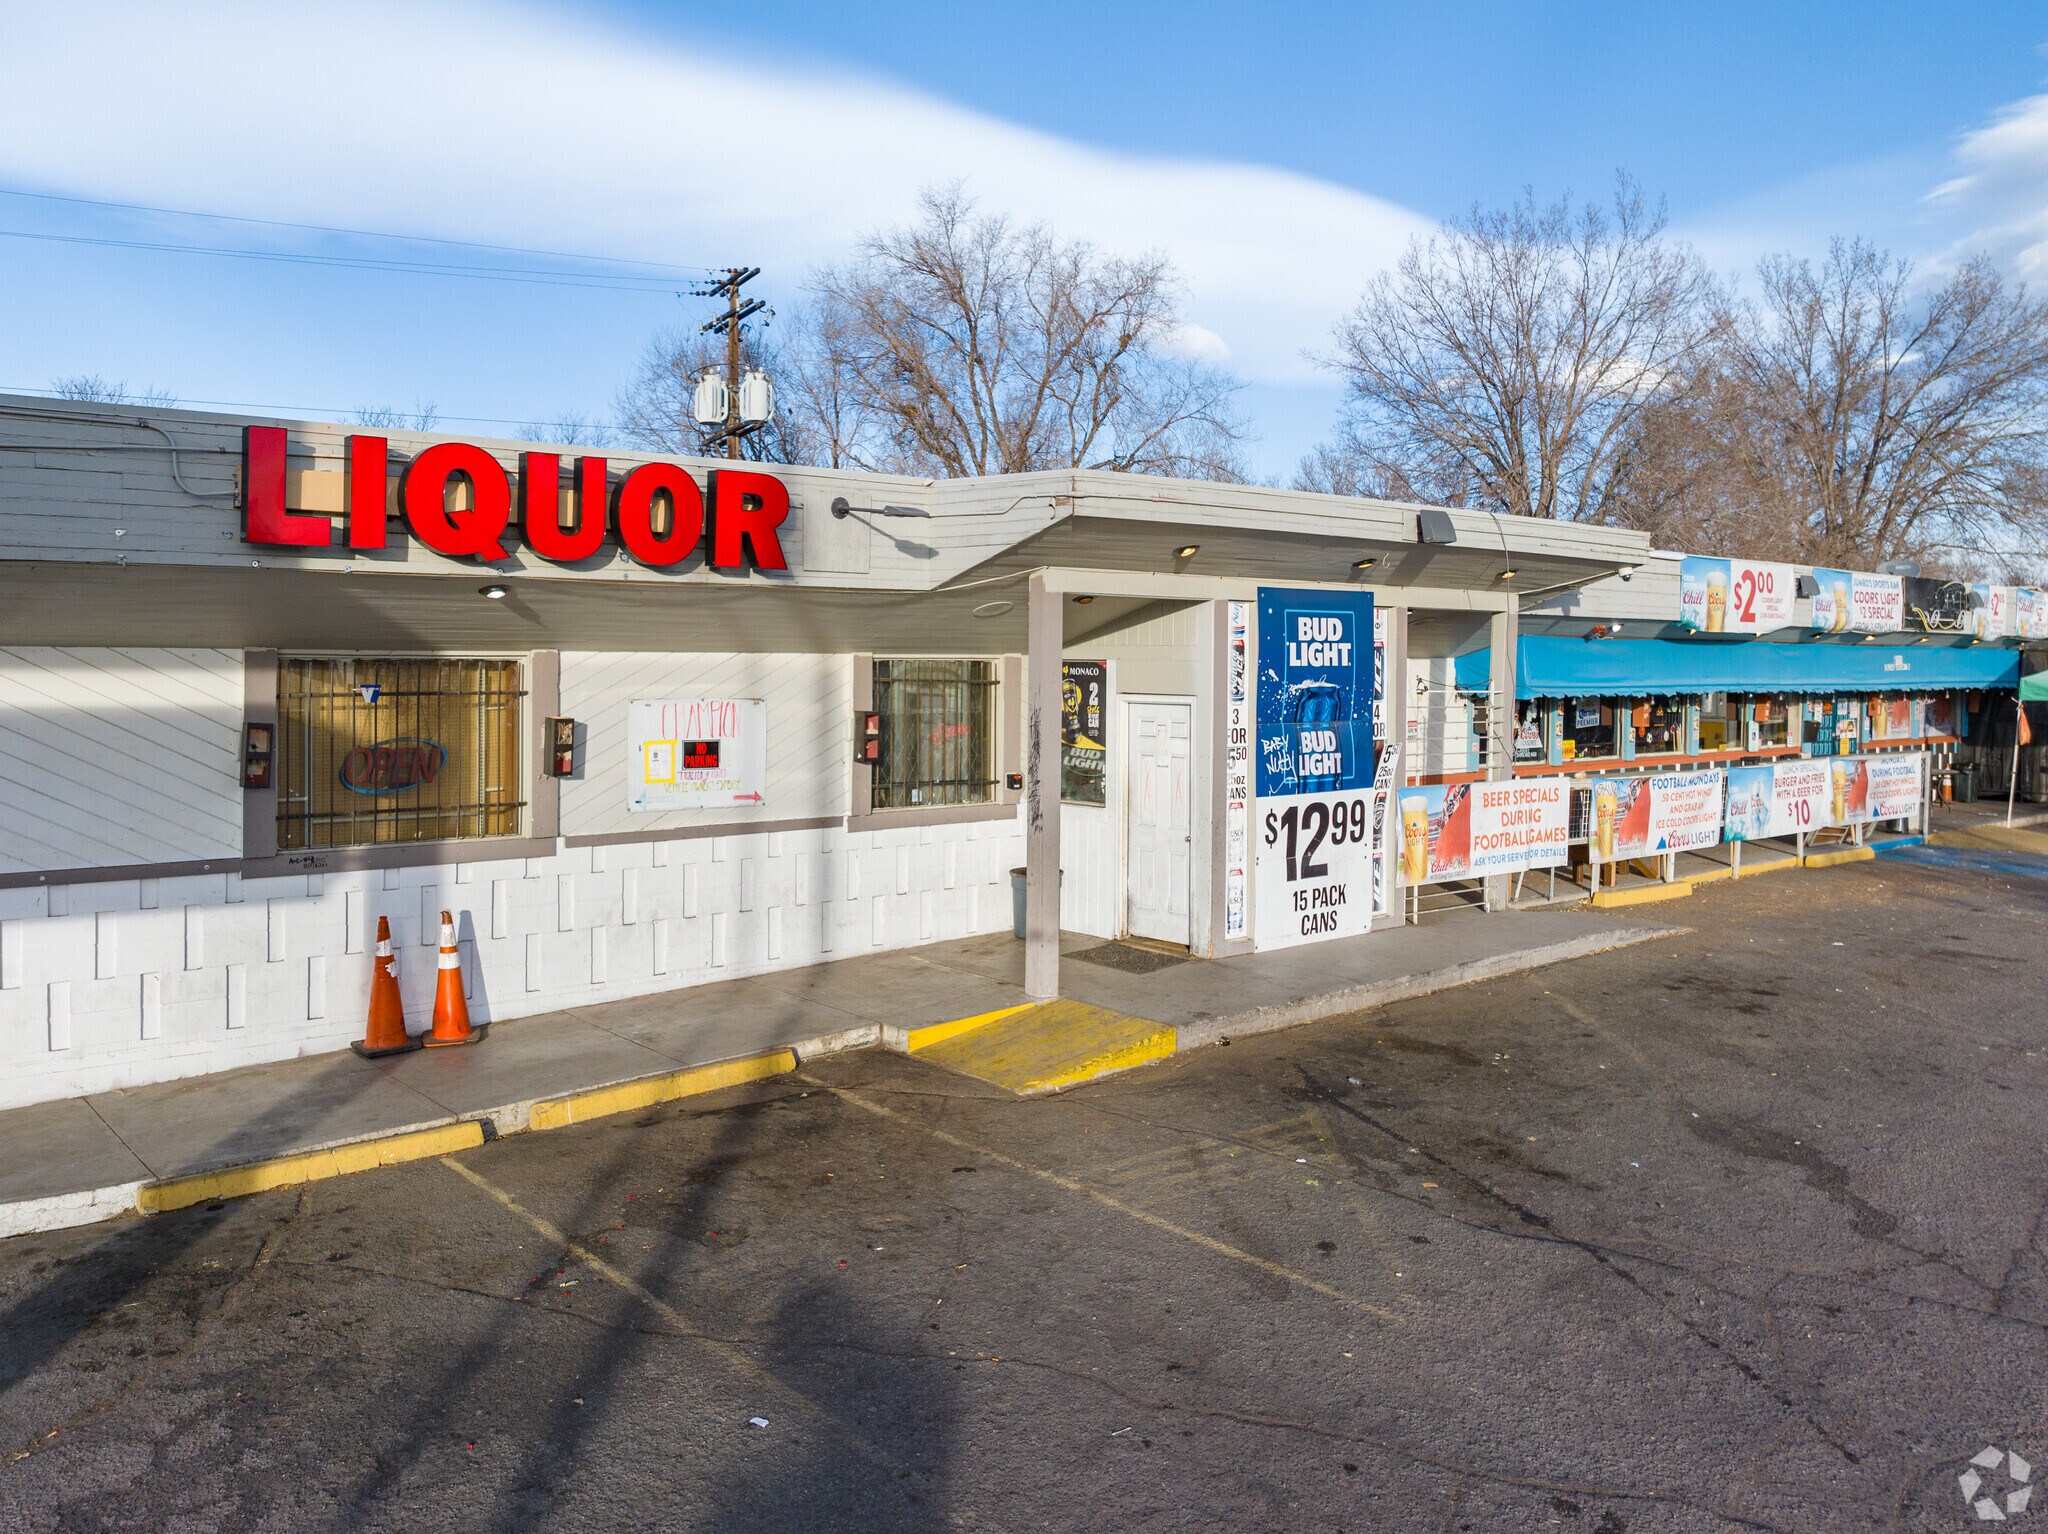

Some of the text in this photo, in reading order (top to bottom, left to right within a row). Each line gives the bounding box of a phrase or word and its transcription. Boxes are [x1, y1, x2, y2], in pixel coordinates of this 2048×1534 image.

[242, 425, 790, 571] LIQUOR
[1683, 590, 1704, 605] Chill
[1815, 599, 1833, 612] Chill
[1854, 591, 1899, 605] COORS LIGHT
[1867, 608, 1893, 619] SPECIAL
[1298, 617, 1343, 641] BUD
[1289, 642, 1351, 667] LIGHT
[1069, 667, 1099, 676] MONACO
[1088, 682, 1099, 706] 2
[661, 700, 741, 739] CHAMPION
[1232, 709, 1240, 725] 3
[1373, 704, 1380, 720] 4
[1373, 722, 1386, 738] OR
[1576, 717, 1599, 728] PREMIER
[695, 741, 707, 755] NO
[1301, 731, 1337, 753] BUD
[685, 754, 718, 768] PARKING
[1070, 747, 1101, 759] BUD
[344, 746, 440, 784] OPEN
[1063, 756, 1105, 771] LIGHT
[1299, 752, 1342, 776] LIGHT
[1652, 772, 1720, 790] FOOTBALL MONDAYS
[1774, 772, 1826, 788] BURGER AND FRIES
[1483, 787, 1560, 808] BEER SPECIALS
[1670, 791, 1684, 802] CENT
[1685, 790, 1696, 800] HOT
[1776, 785, 1823, 799] WITH A BEER FOR
[1670, 804, 1683, 814] AND
[1730, 800, 1748, 817] Chill
[1787, 799, 1811, 826] $10
[1899, 803, 1916, 814] LIGHT
[1501, 808, 1542, 827] DURING
[1656, 819, 1665, 829] ICE
[1666, 817, 1682, 828] COLD
[1699, 812, 1717, 823] LIGHT
[1405, 824, 1428, 838] Coors
[1407, 838, 1425, 847] LIGHT
[1668, 830, 1716, 849] Coors LIGHT
[1431, 857, 1450, 873] Chill
[1474, 856, 1487, 867] ASK
[1488, 853, 1507, 865] YOUR
[1540, 847, 1567, 858] DETAILS
[1293, 884, 1347, 912] 15 PACK
[1301, 910, 1338, 936] CANS
